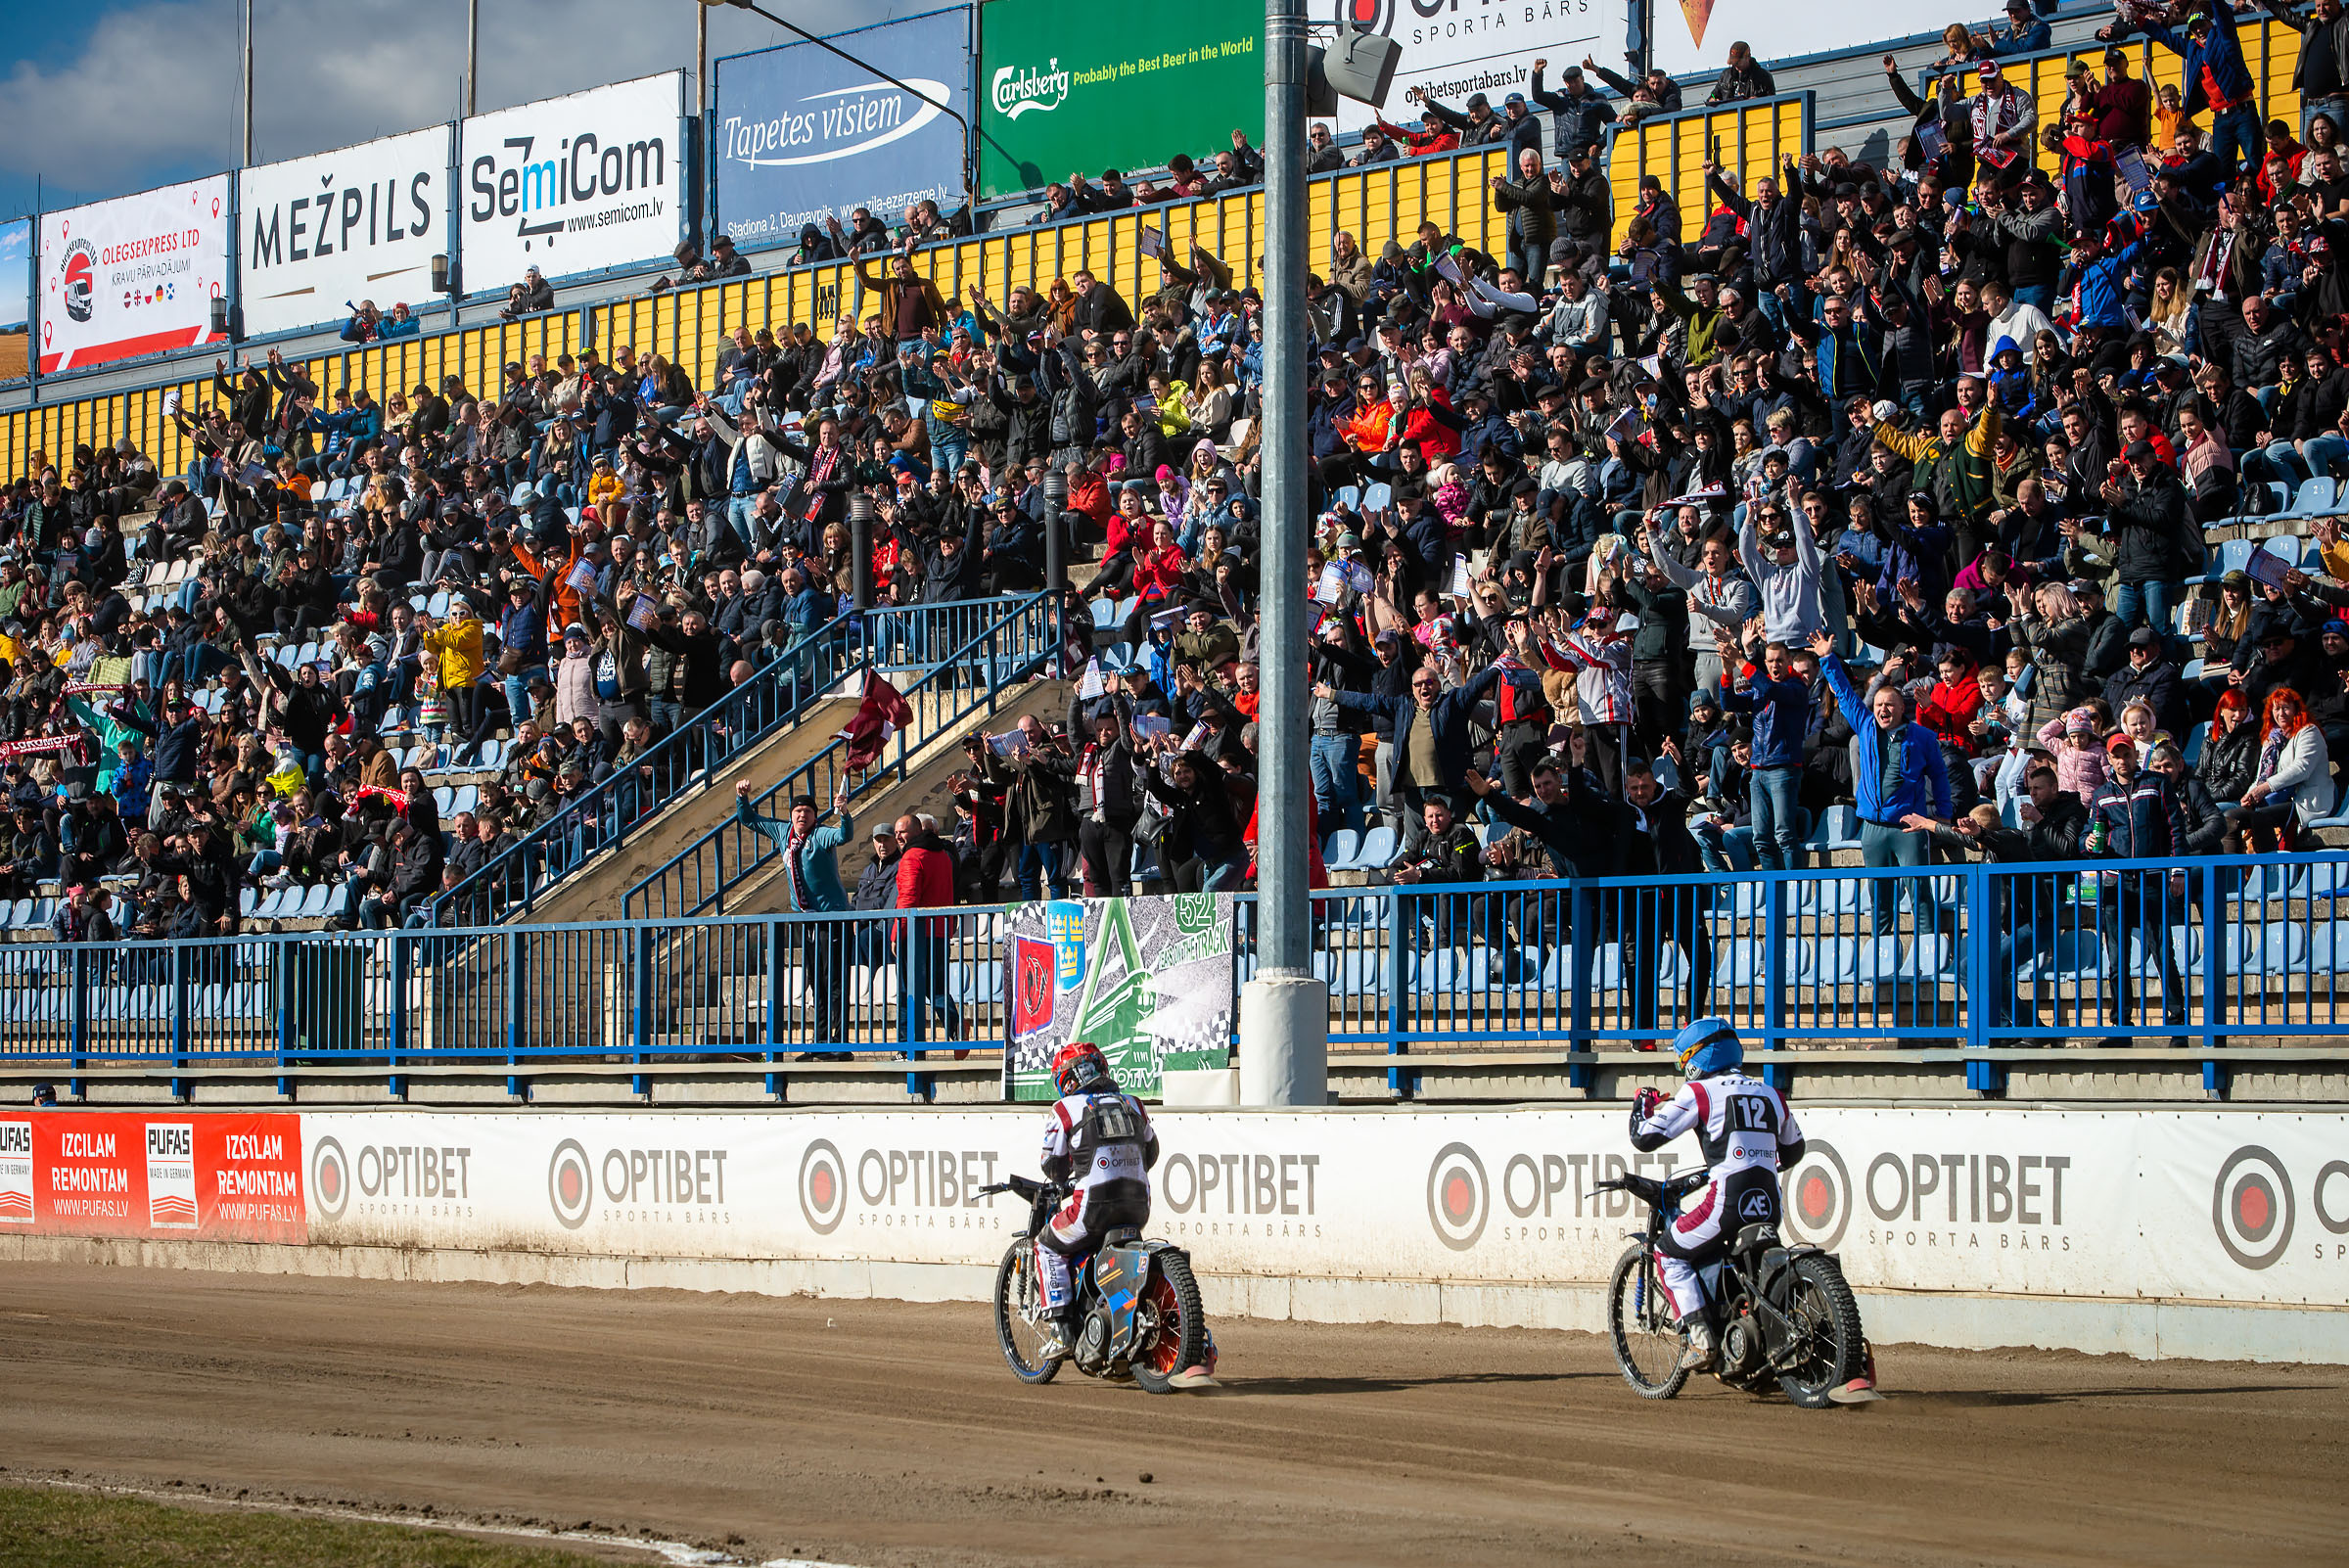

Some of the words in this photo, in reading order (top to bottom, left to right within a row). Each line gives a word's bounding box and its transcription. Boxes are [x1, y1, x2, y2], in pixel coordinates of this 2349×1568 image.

[1413, 13, 1505, 44] SPORTA
[1073, 63, 1118, 86] Probably
[1120, 61, 1135, 77] the
[1138, 57, 1161, 73] Best
[1163, 53, 1186, 68] Beer
[1188, 48, 1199, 63] in
[1201, 45, 1219, 61] the
[1221, 36, 1254, 57] World
[991, 61, 1070, 116] Carlsberg
[724, 111, 815, 171] Tapetes
[822, 94, 901, 140] visiem
[471, 133, 665, 223] SemiCom
[253, 172, 431, 270] MEŽPILS
[567, 197, 664, 233] www.semicom.lv
[727, 219, 767, 239] Stadiona
[769, 213, 779, 234] 2,
[102, 232, 178, 265] OLEGSEXPRESS
[182, 228, 200, 249] LTD
[112, 270, 136, 287] KRAVU
[137, 257, 191, 281] PĀRVADĀJUMI
[1180, 891, 1213, 927] 52
[1196, 921, 1229, 959] TRACK
[1098, 1108, 1127, 1136] 11
[1737, 1096, 1768, 1130] 12
[62, 1132, 116, 1158] IZCILAM
[148, 1129, 190, 1155] PUFAS
[225, 1134, 283, 1161] IZCILAM
[1748, 1149, 1776, 1160] OPTIBET
[149, 1168, 162, 1178] MADE
[169, 1168, 192, 1178] GERMANY
[358, 1146, 472, 1200] OPTIBET
[603, 1148, 728, 1204] OPTIBET
[857, 1148, 998, 1208] OPTIBET
[1111, 1158, 1141, 1169] OPTIBET
[51, 1167, 128, 1193] REMONTAM
[216, 1170, 297, 1197] REMONTAM
[1163, 1152, 1320, 1216] OPTIBET
[1503, 1153, 1680, 1219] OPTIBET
[1866, 1151, 2071, 1225] OPTIBET
[53, 1199, 129, 1218] WWW.PUFAS.LV
[217, 1203, 298, 1222] WWW.PUFAS.LV
[359, 1202, 426, 1217] SPORTA
[433, 1202, 473, 1220] BĀRS
[603, 1208, 673, 1223] SPORTA
[686, 1207, 731, 1225] BĀRS
[858, 1213, 938, 1228] SPORTA
[949, 1212, 1000, 1230] BĀRS
[1165, 1220, 1252, 1237] SPORTA
[1265, 1219, 1322, 1238] BĀRS
[1504, 1226, 1601, 1241] SPORTA
[1869, 1229, 1980, 1249] SPORTA
[2001, 1227, 2071, 1252] BĀRS
